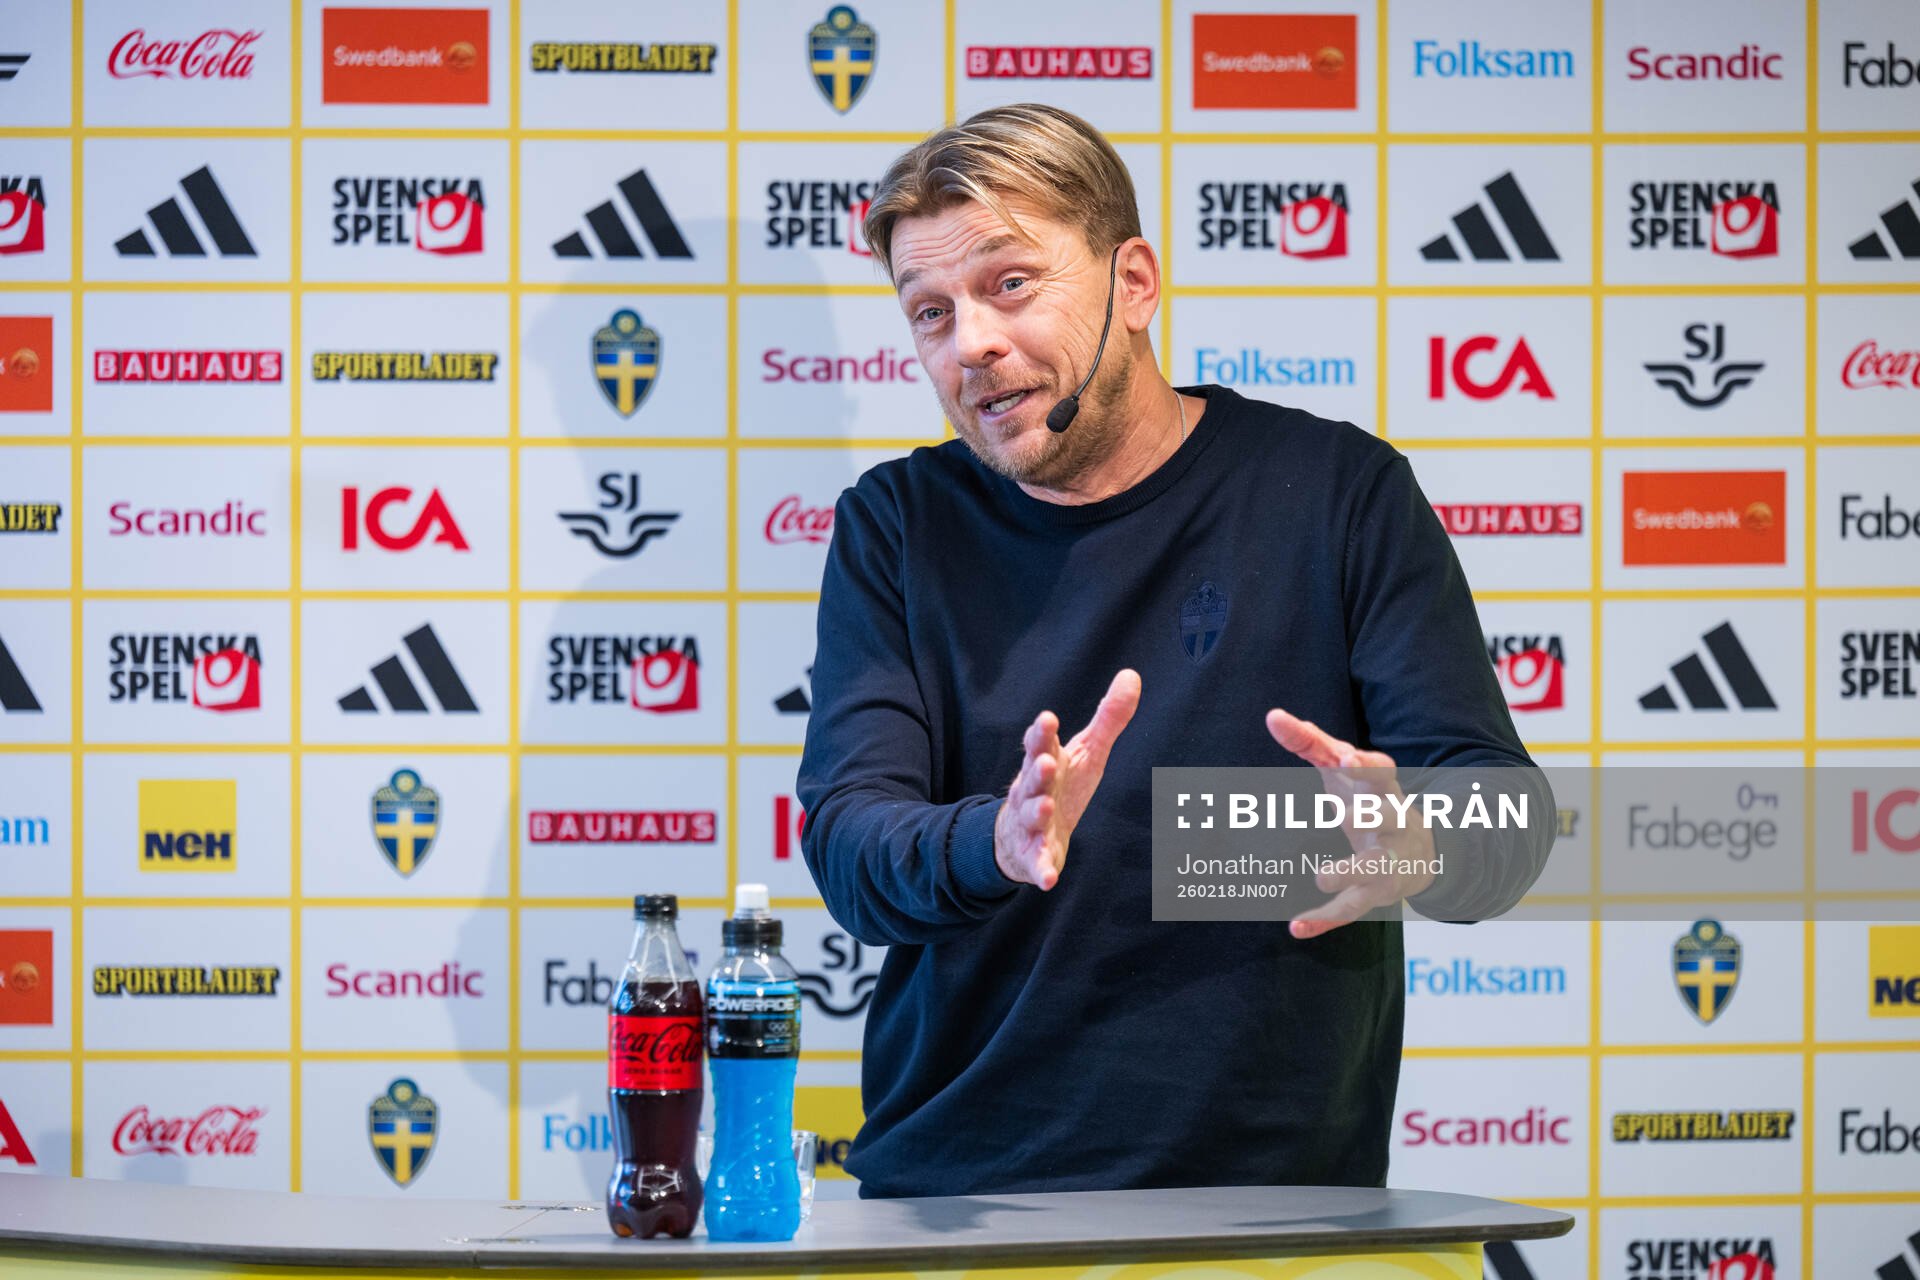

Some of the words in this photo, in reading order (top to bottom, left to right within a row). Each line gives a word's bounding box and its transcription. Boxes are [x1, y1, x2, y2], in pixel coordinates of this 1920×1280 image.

[108, 29, 264, 79] Coca-Cola
[333, 45, 443, 68] Swedbank
[531, 42, 718, 74] SPORTBLADET
[968, 48, 1152, 77] BAUHAUS
[1203, 51, 1312, 73] Swedbank
[1414, 41, 1574, 78] Folksam
[1627, 45, 1783, 80] Scandic
[1843, 41, 1920, 88] Fab
[766, 181, 879, 213] SVENS
[333, 213, 411, 246] SPEL
[766, 216, 843, 248] SPEL
[1199, 217, 1275, 249] SPEL
[1629, 216, 1707, 249] SPEL
[1683, 323, 1725, 363] SJ
[96, 353, 281, 381] BAUHAUS
[312, 352, 500, 383] SPORTBLADET
[762, 348, 918, 383] Scandic
[1195, 349, 1355, 386] Folksam
[1429, 335, 1556, 401] ICA
[599, 472, 640, 512] SJ
[109, 501, 266, 536] Scandic
[342, 485, 471, 552] ICA
[1632, 507, 1740, 530] Swedbank
[1840, 494, 1920, 539] Fab
[1841, 632, 1920, 662] SVEN
[110, 669, 187, 702] SPEL
[548, 671, 626, 703] SPEL
[1841, 666, 1917, 698] SPEL
[531, 813, 716, 842] BAUHAUS
[1629, 803, 1777, 861] Fabege
[1852, 787, 1920, 854] IC
[822, 932, 861, 974] SJ
[93, 966, 281, 997] SPORTBLADET
[327, 961, 484, 998] Scandic
[544, 959, 613, 1007] Fab
[1407, 958, 1567, 995] Folksam
[112, 1104, 267, 1157] Coca-Cola
[544, 1112, 614, 1152] Folk
[1402, 1107, 1571, 1147] Scandic
[1612, 1110, 1797, 1144] SPORTBLADET
[1839, 1109, 1920, 1155] Fab
